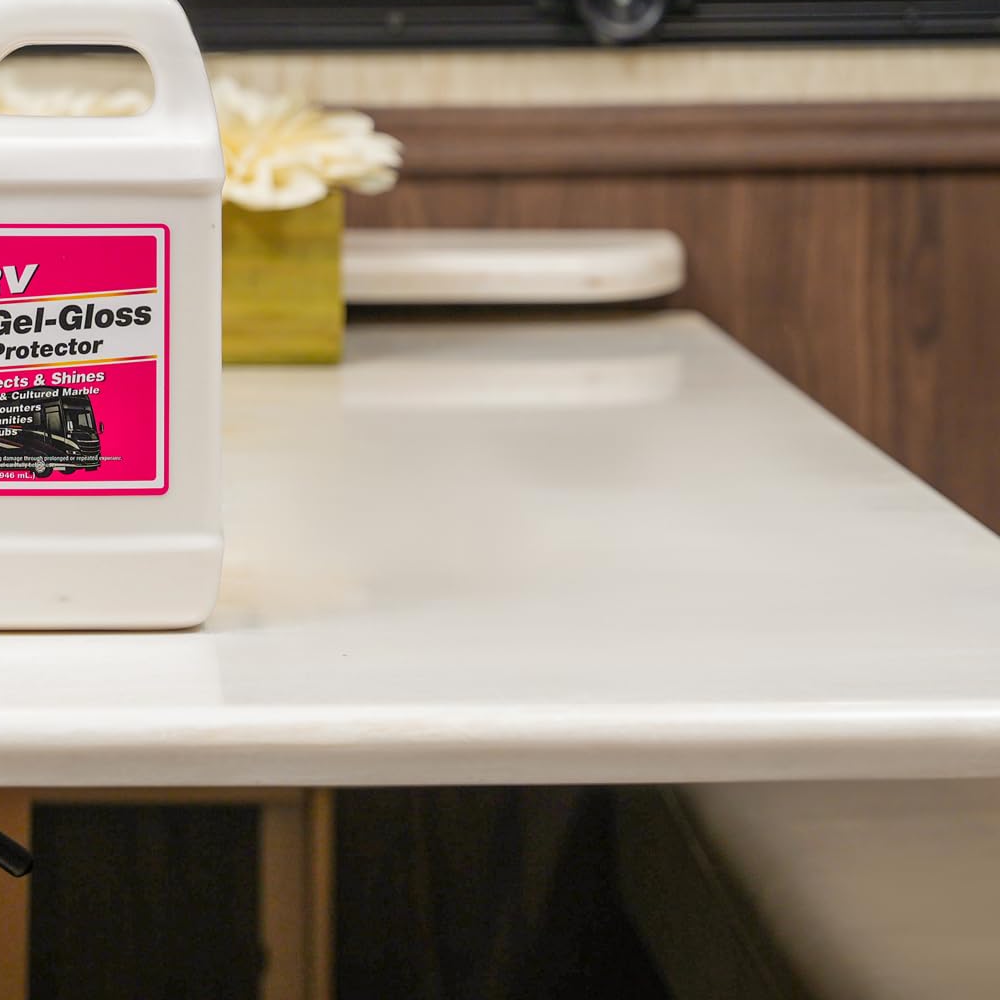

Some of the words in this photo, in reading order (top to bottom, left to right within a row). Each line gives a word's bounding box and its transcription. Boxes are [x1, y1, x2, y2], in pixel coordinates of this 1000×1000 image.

[34, 374, 46, 386] &
[51, 370, 105, 385] Shines
[12, 389, 59, 399] Cultured
[62, 386, 100, 395] Marble
